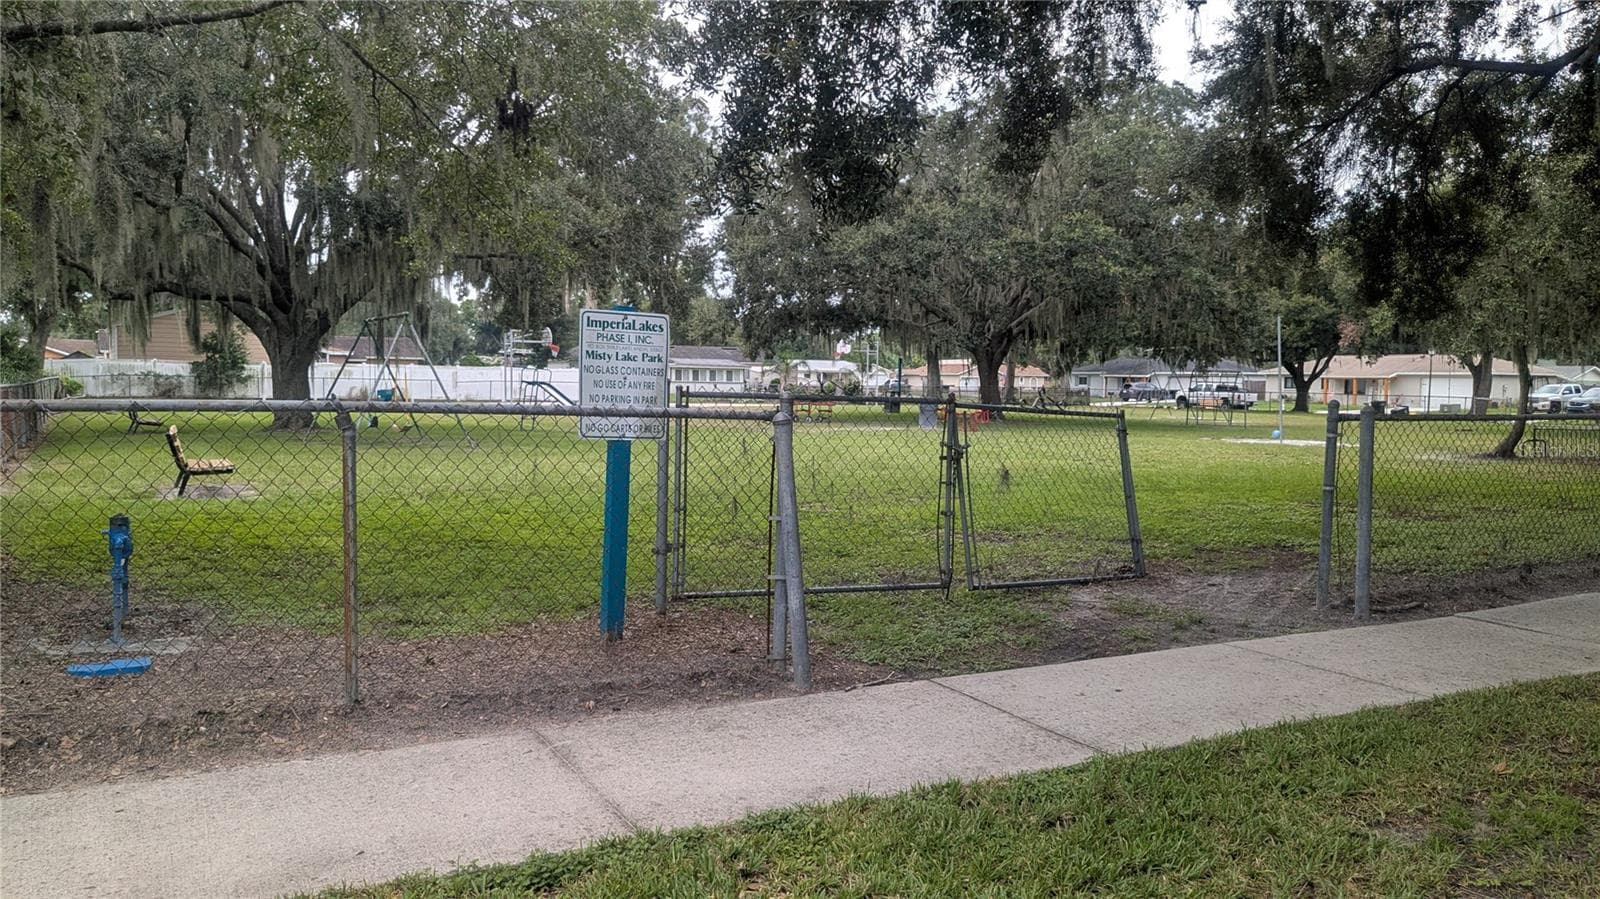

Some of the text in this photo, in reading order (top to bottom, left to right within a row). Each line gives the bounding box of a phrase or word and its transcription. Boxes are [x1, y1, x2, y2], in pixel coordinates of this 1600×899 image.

[586, 316, 665, 333] ImperiaLakes
[596, 332, 625, 343] PHASE
[635, 336, 654, 345] INC.
[585, 350, 664, 363] Misty Lake Park
[583, 365, 664, 377] NO GLASS CONTAINERS
[593, 380, 656, 391] NO USE OF ANY FIRE
[589, 394, 658, 405] NO PARKING IN PARK
[585, 423, 596, 433] NO
[597, 423, 609, 433] GO
